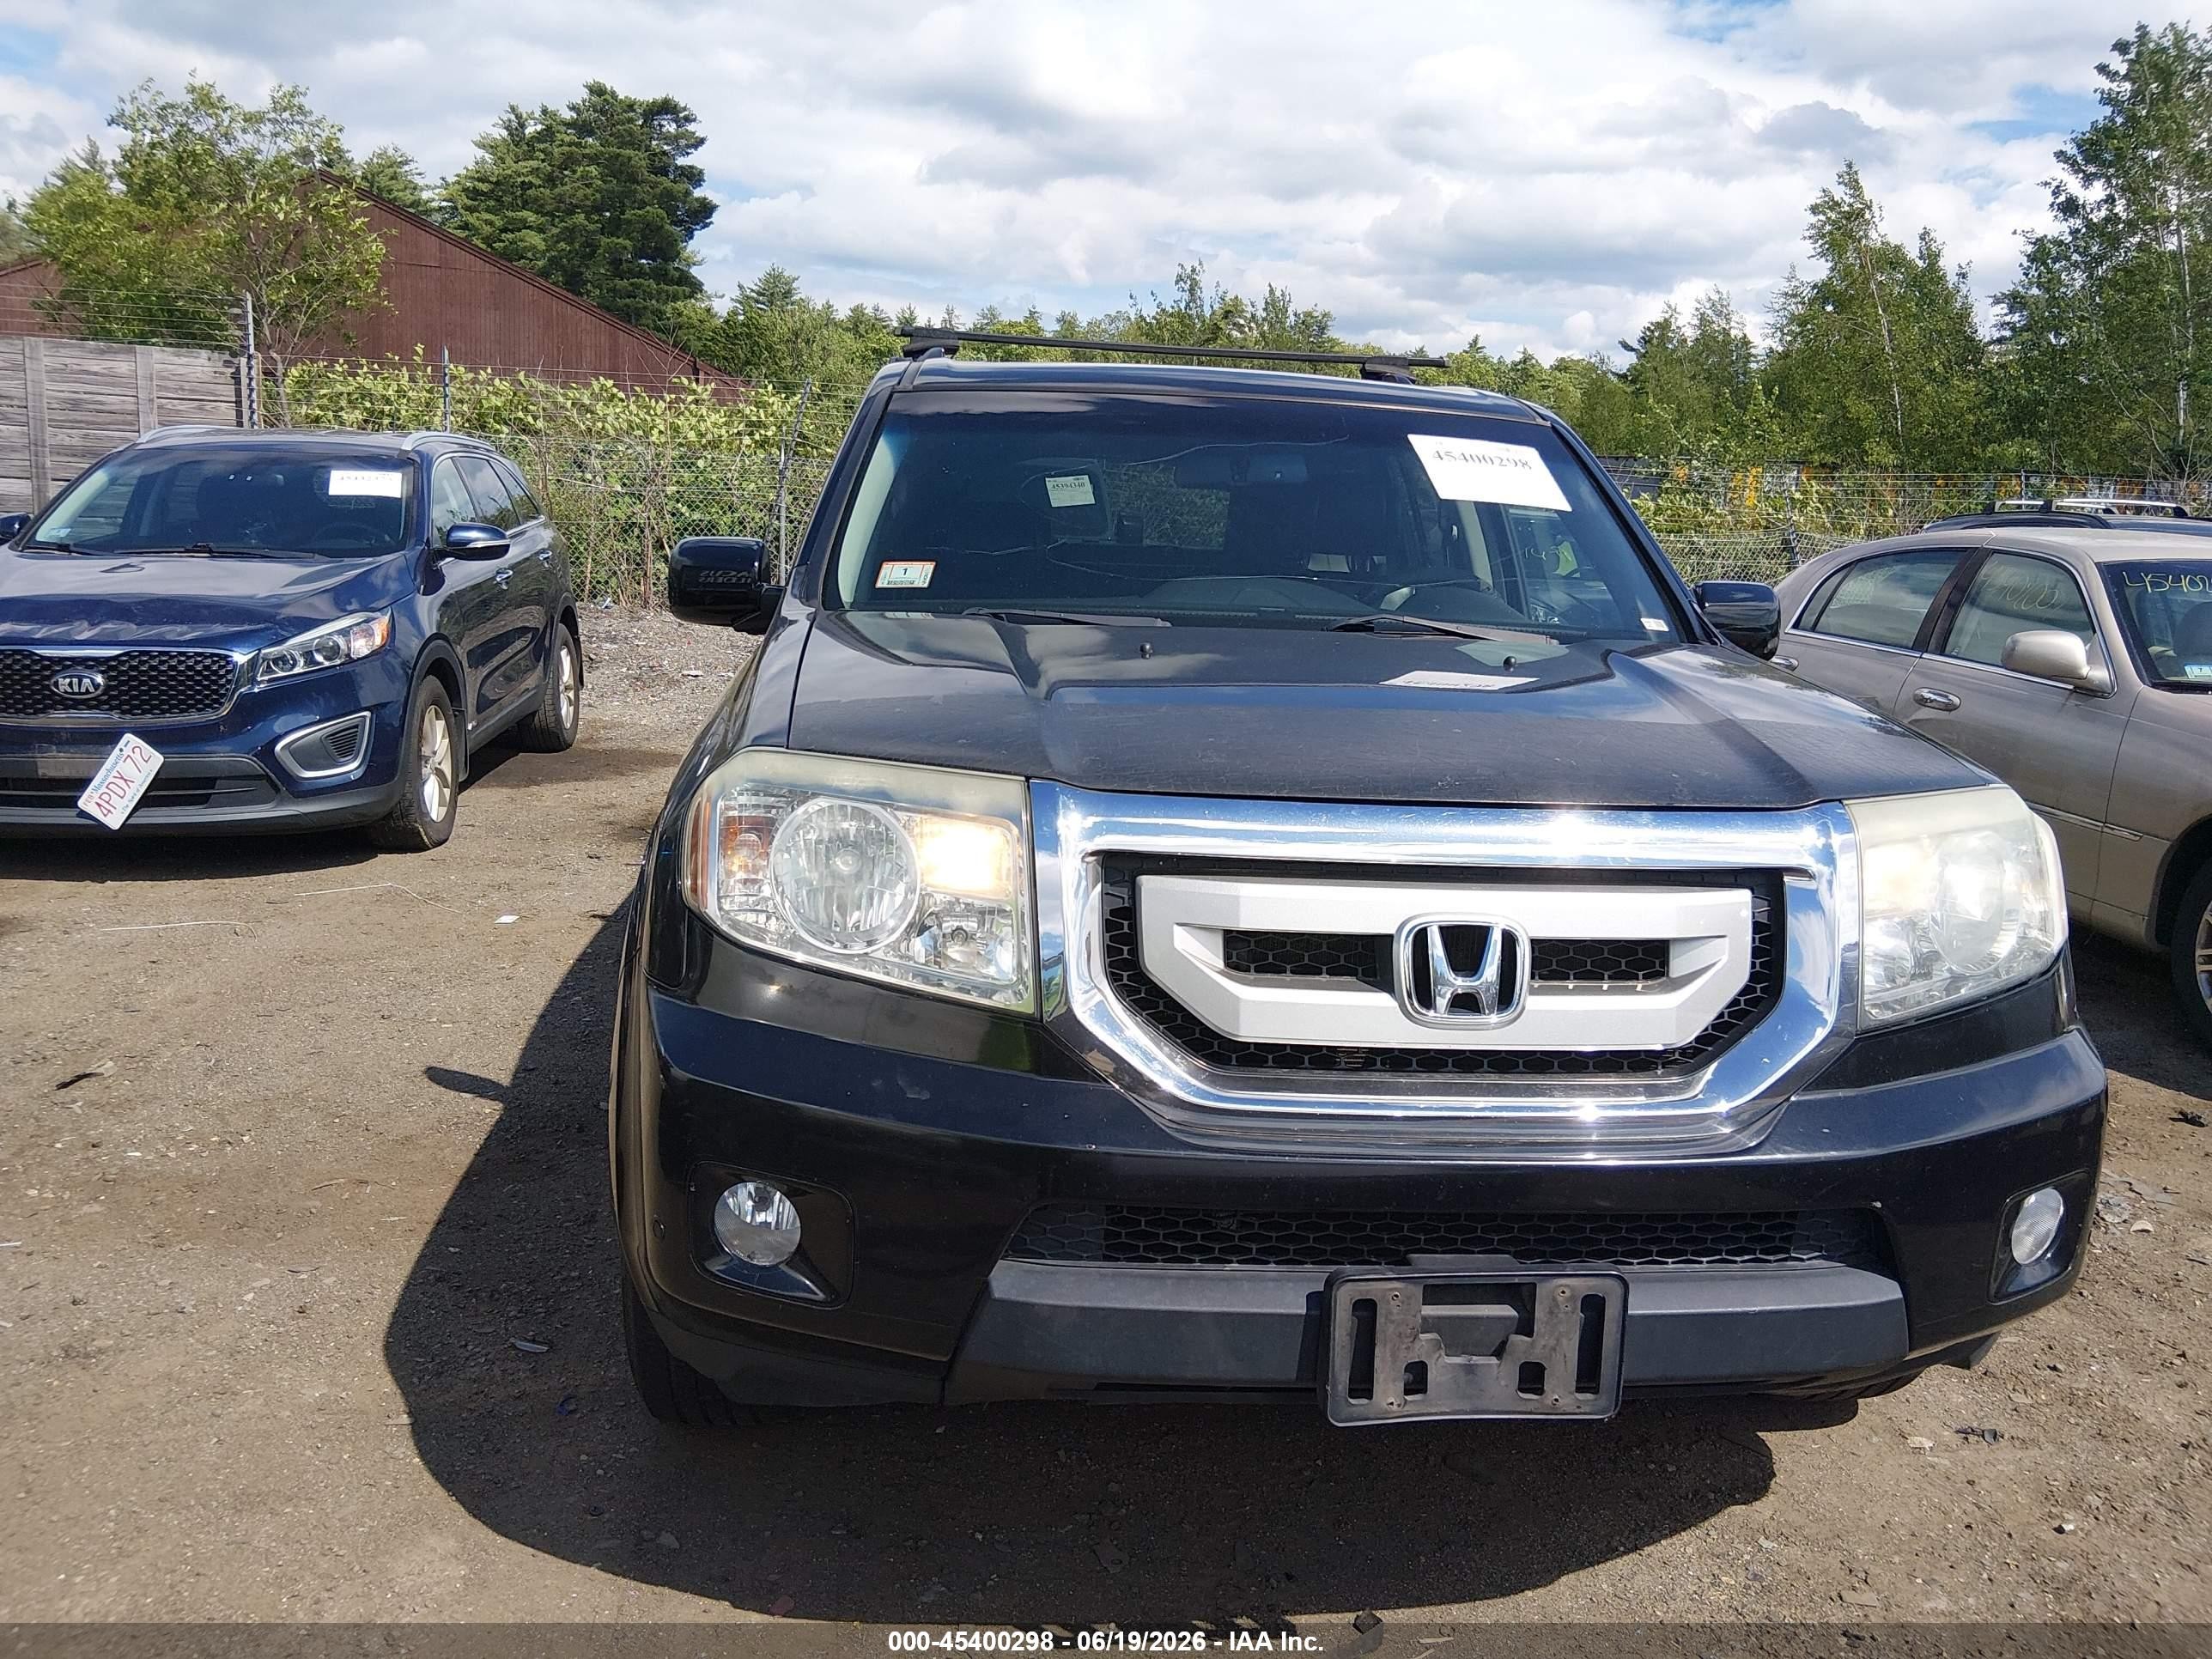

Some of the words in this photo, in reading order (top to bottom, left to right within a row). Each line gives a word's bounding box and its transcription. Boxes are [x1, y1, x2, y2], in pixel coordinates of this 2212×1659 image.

[1432, 450, 1532, 471] 45400298
[902, 568, 908, 576] 1
[58, 678, 95, 693] KIA
[92, 751, 125, 794] Massachusetts
[94, 769, 136, 817] 4PDX
[123, 745, 152, 774] 72
